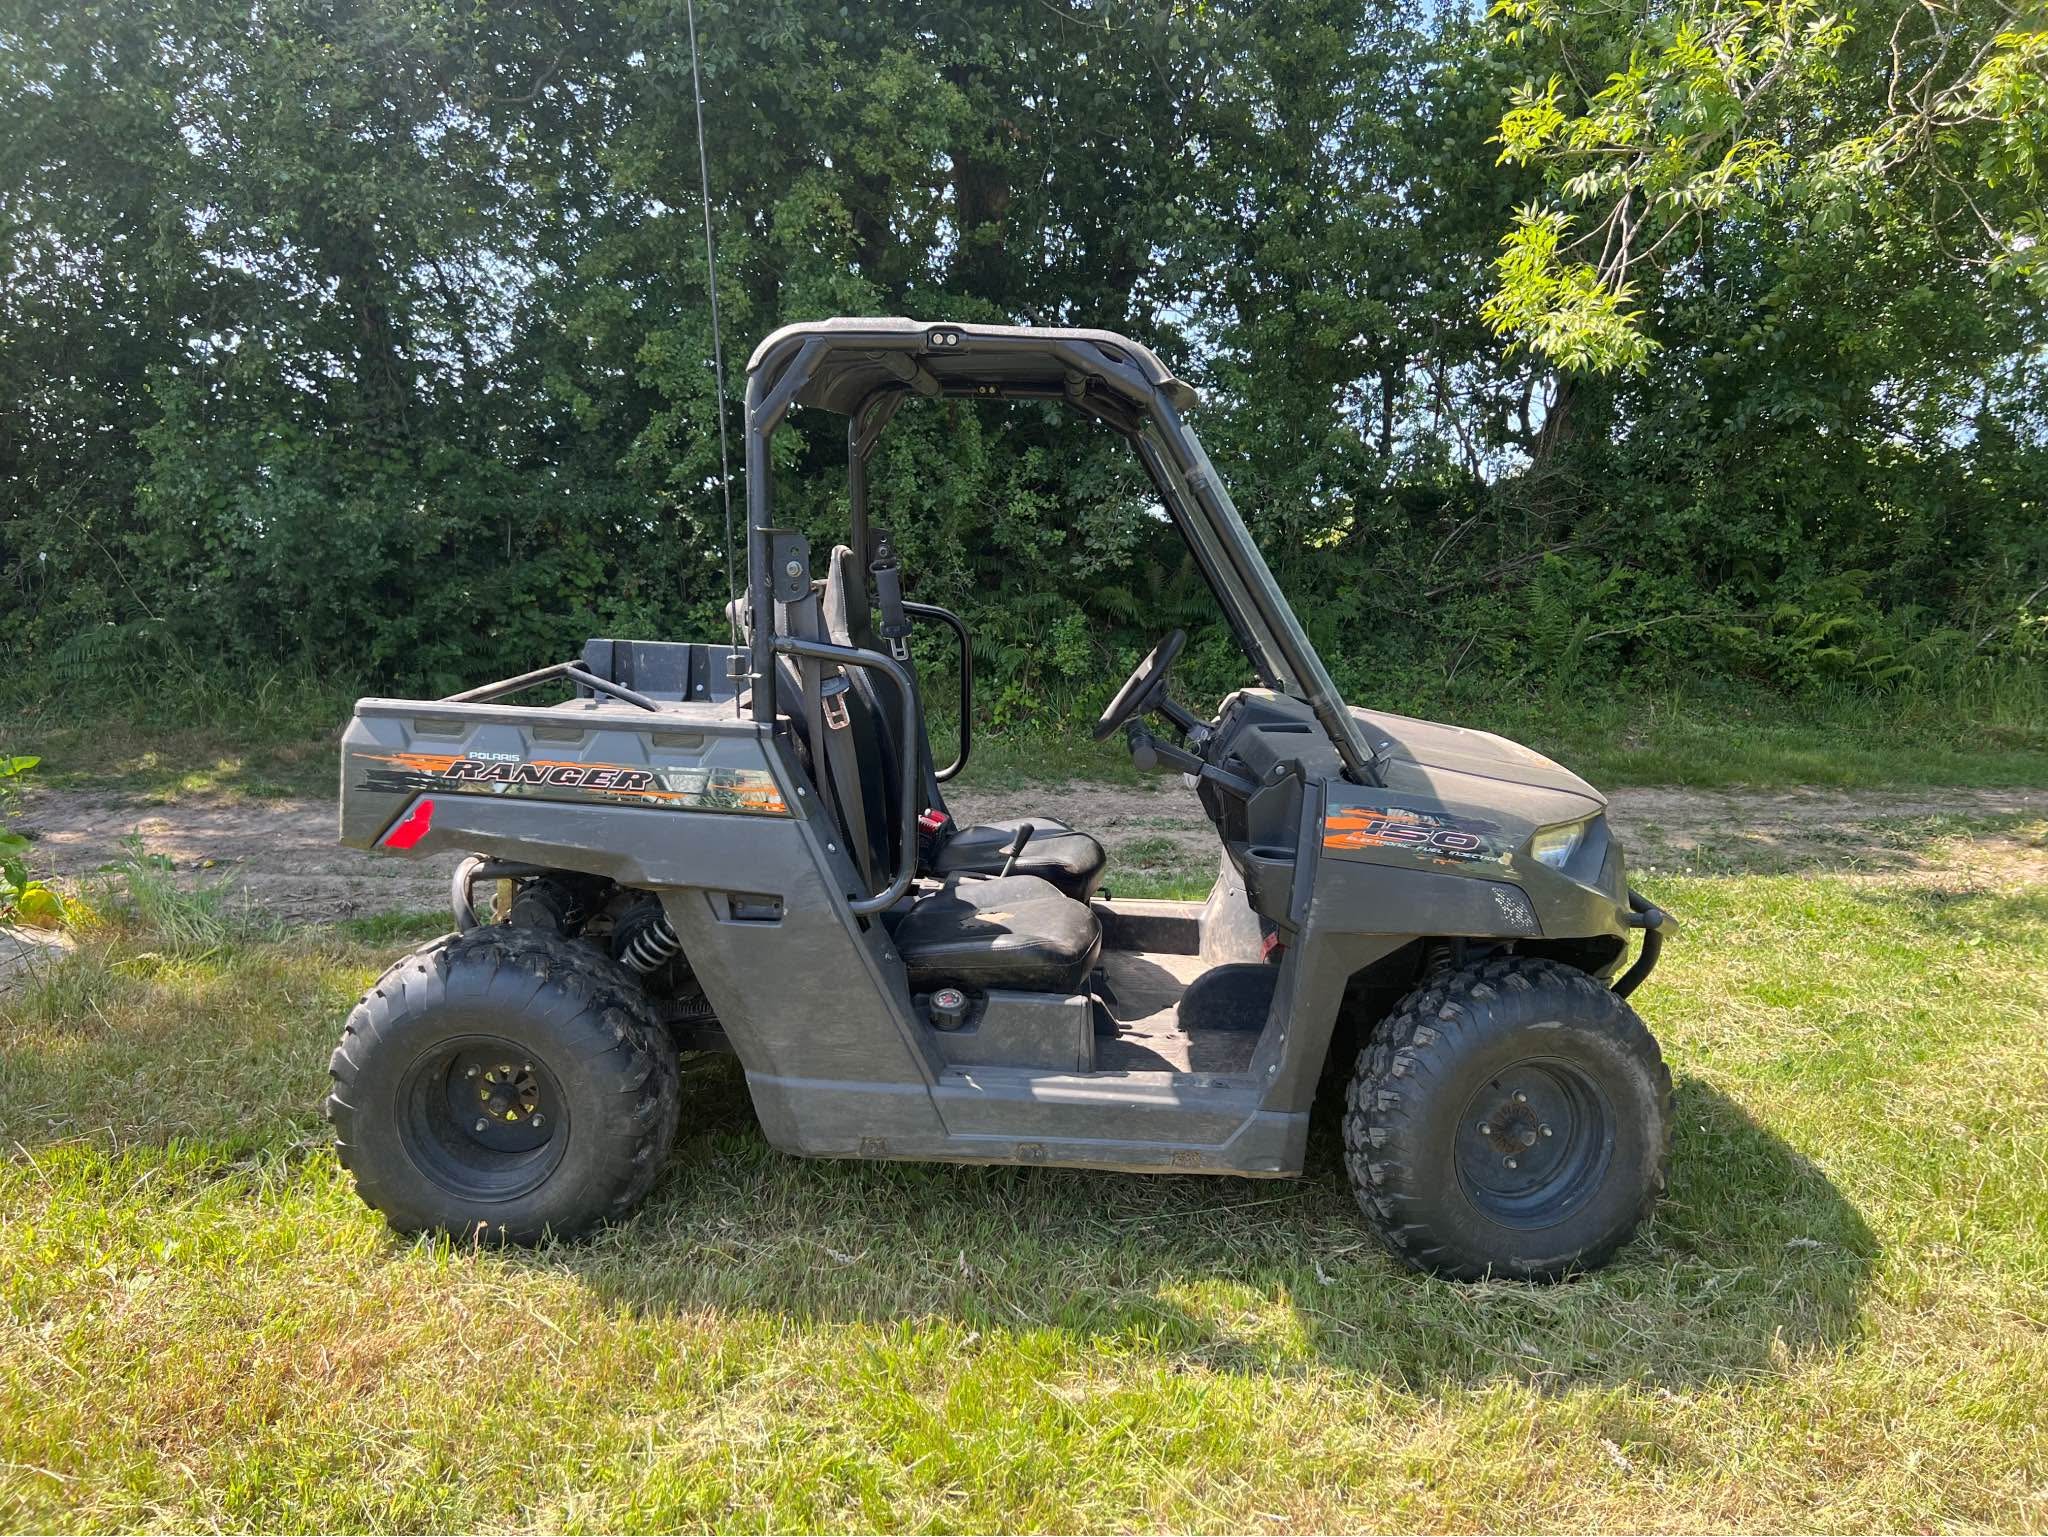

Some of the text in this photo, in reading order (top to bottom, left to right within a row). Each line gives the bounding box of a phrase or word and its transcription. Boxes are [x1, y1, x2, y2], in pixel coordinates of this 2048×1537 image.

[469, 751, 520, 762] POLARIS
[443, 760, 653, 791] RANGER
[1346, 836, 1411, 849] ELECTRONIC
[1415, 845, 1444, 854] FUEL
[1362, 820, 1481, 850] 150
